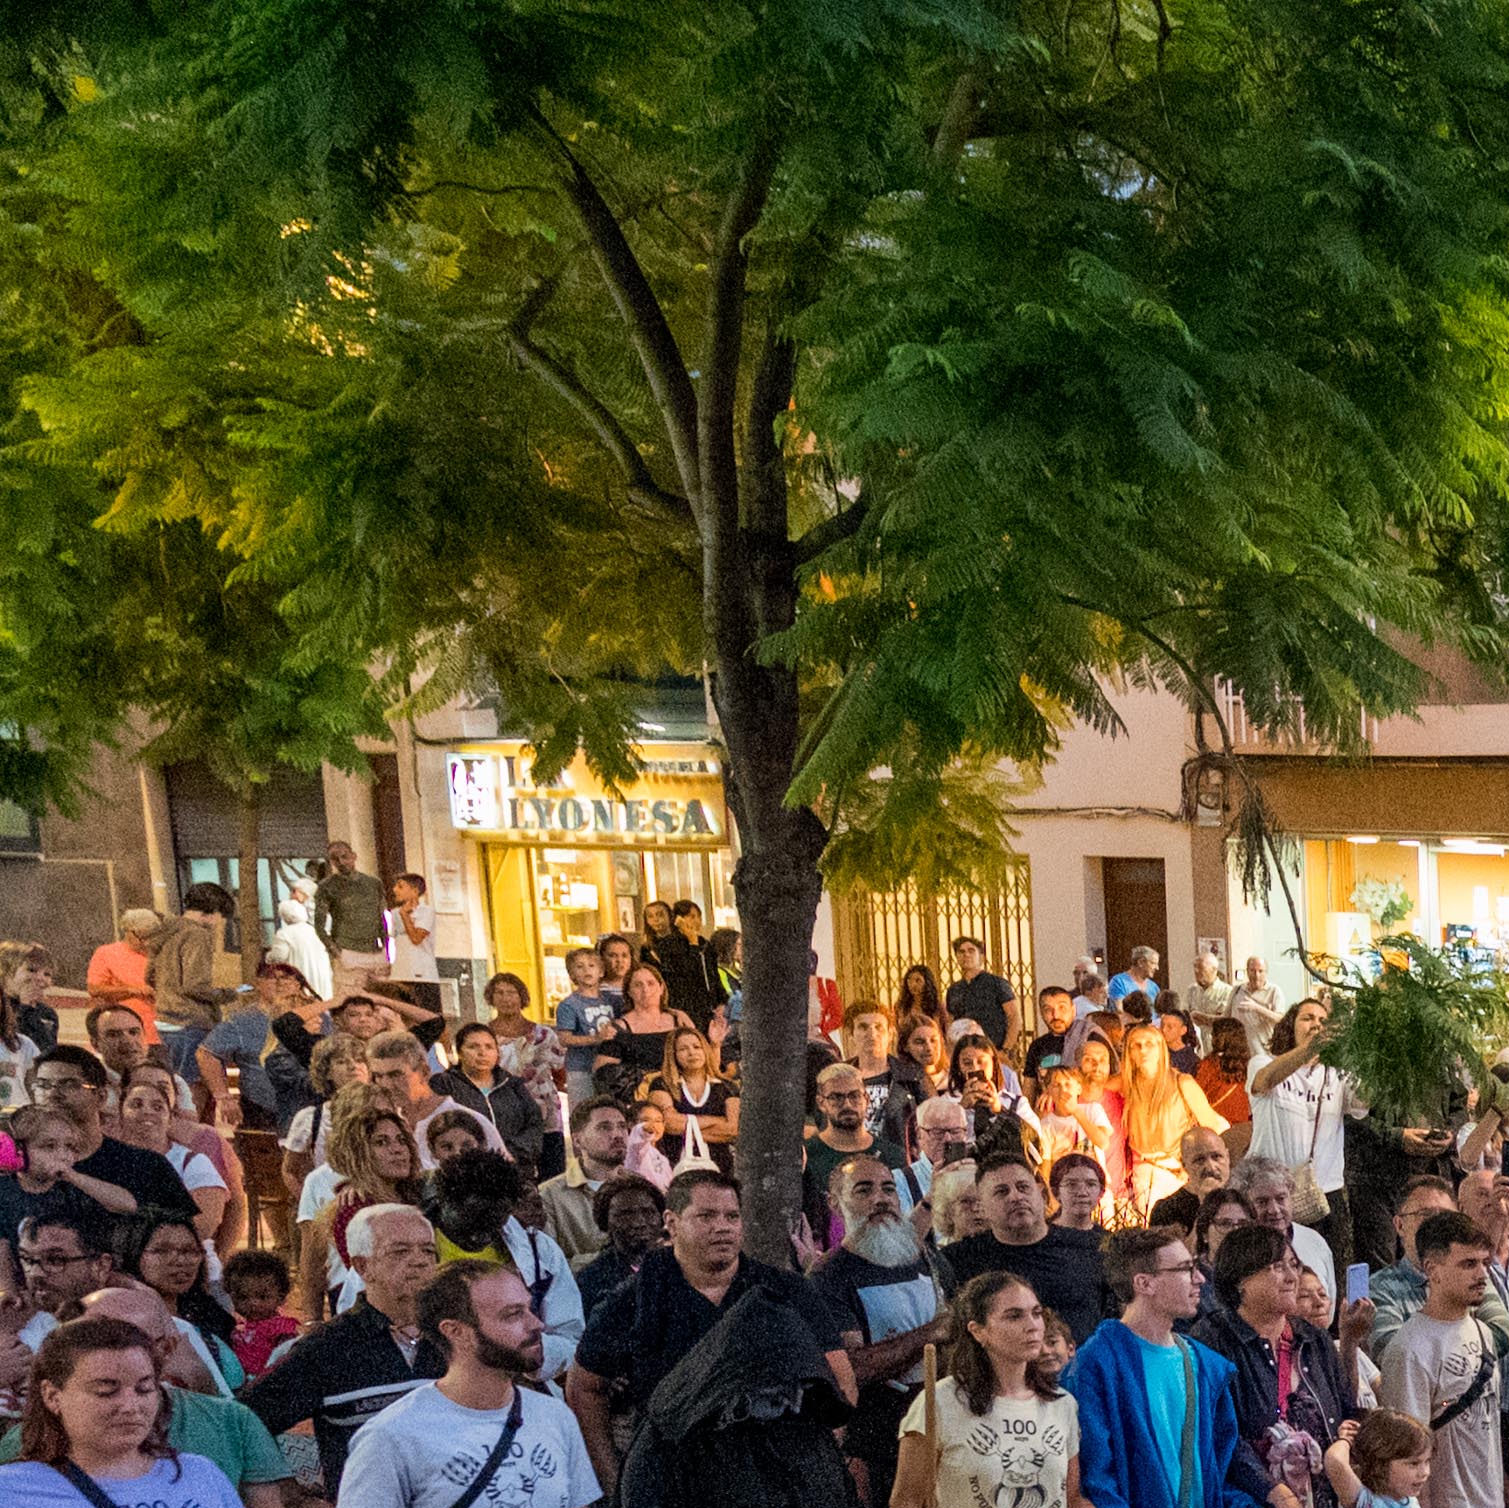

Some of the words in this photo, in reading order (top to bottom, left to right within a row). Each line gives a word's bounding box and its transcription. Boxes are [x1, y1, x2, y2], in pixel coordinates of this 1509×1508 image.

[508, 797, 718, 834] LYONESA
[1002, 1418, 1037, 1436] 100
[481, 1441, 524, 1460] 10
